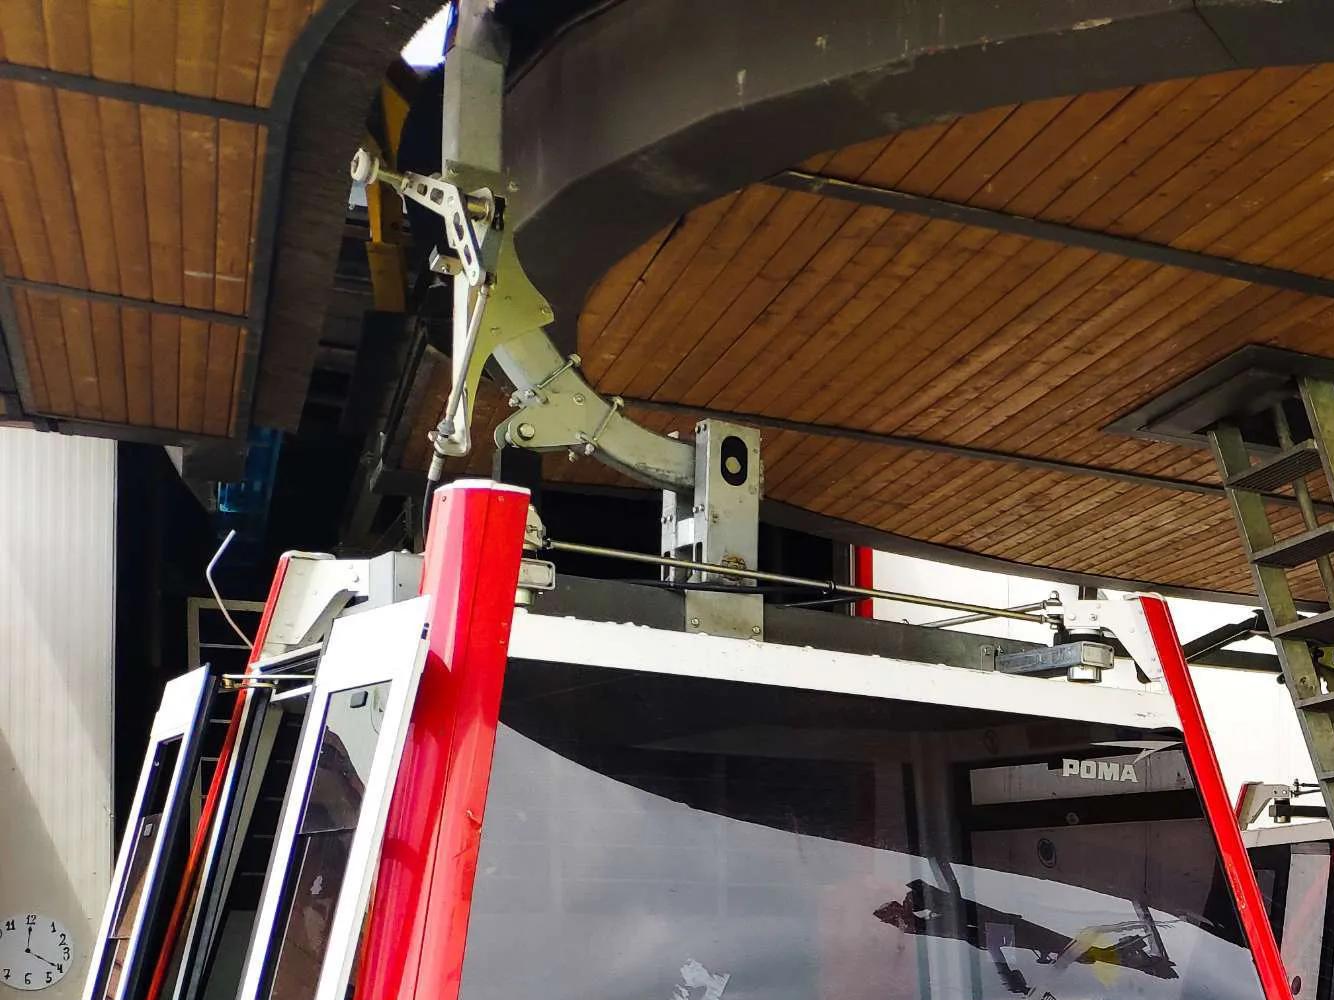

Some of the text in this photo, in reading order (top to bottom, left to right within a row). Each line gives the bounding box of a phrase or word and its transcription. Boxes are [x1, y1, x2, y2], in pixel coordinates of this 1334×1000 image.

[1062, 758, 1138, 782] POMA
[5, 919, 16, 931] 11
[25, 914, 37, 925] 12
[50, 921, 57, 933] 1
[58, 933, 68, 946] 2
[63, 946, 70, 961] 3
[3, 968, 11, 980] 7
[56, 963, 64, 974] 4
[24, 972, 32, 985] 6
[45, 971, 52, 984] 5
